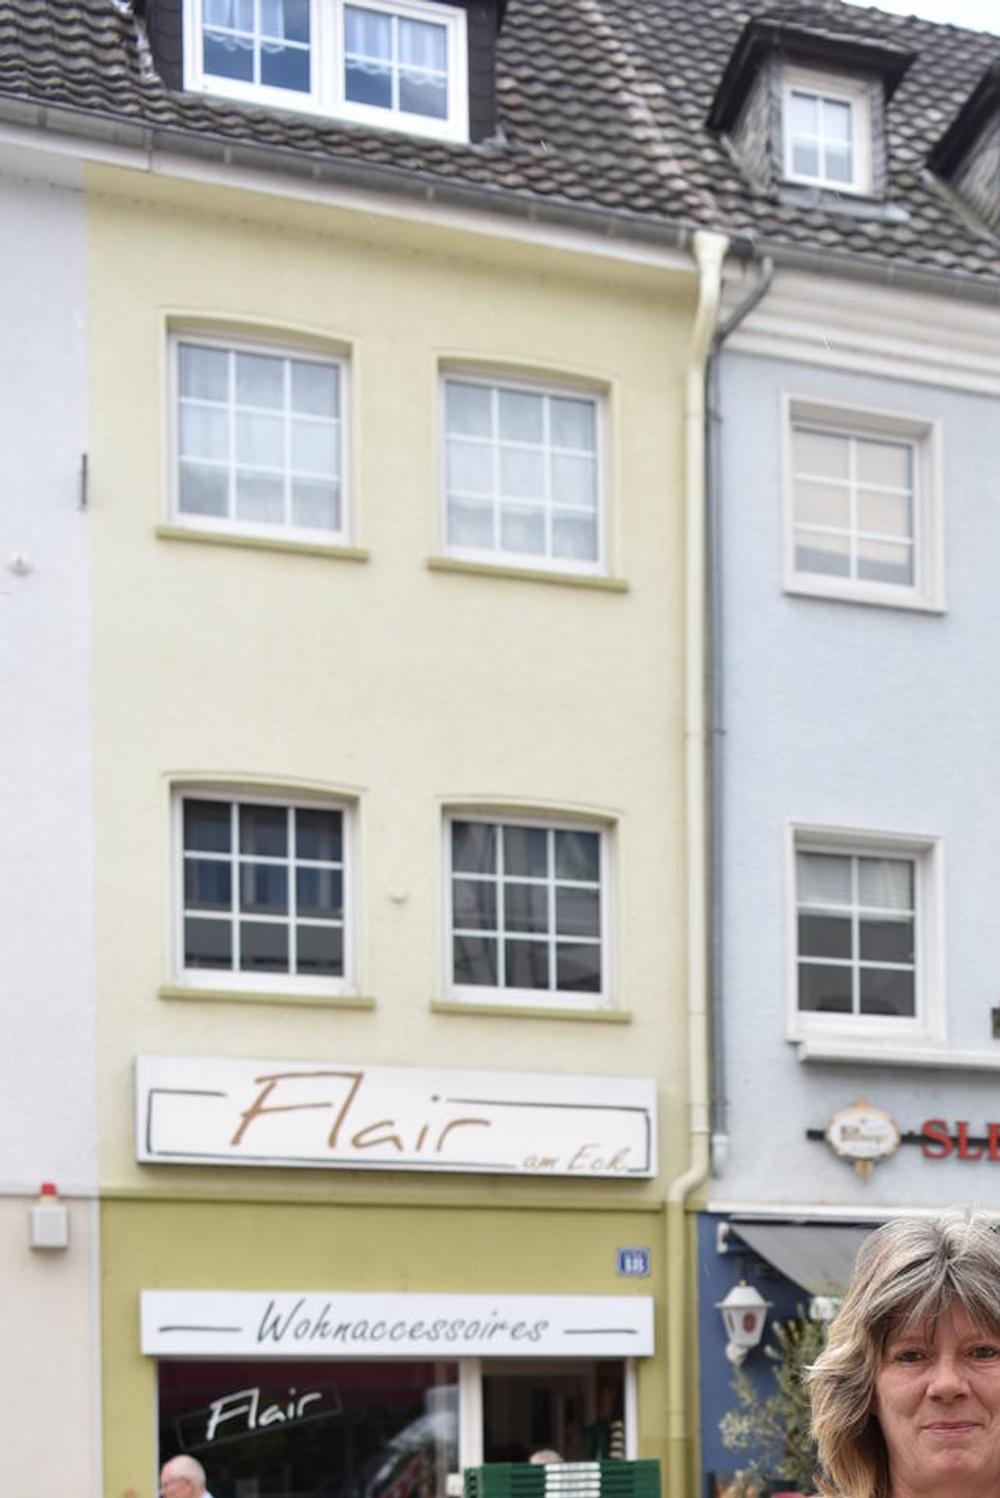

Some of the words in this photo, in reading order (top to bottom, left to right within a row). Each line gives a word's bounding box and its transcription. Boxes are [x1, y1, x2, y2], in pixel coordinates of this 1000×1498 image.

[229, 1071, 491, 1152] Flair
[522, 1154, 556, 1170] am
[255, 1299, 550, 1345] Wohnaccessoires
[205, 1387, 322, 1440] Flair
